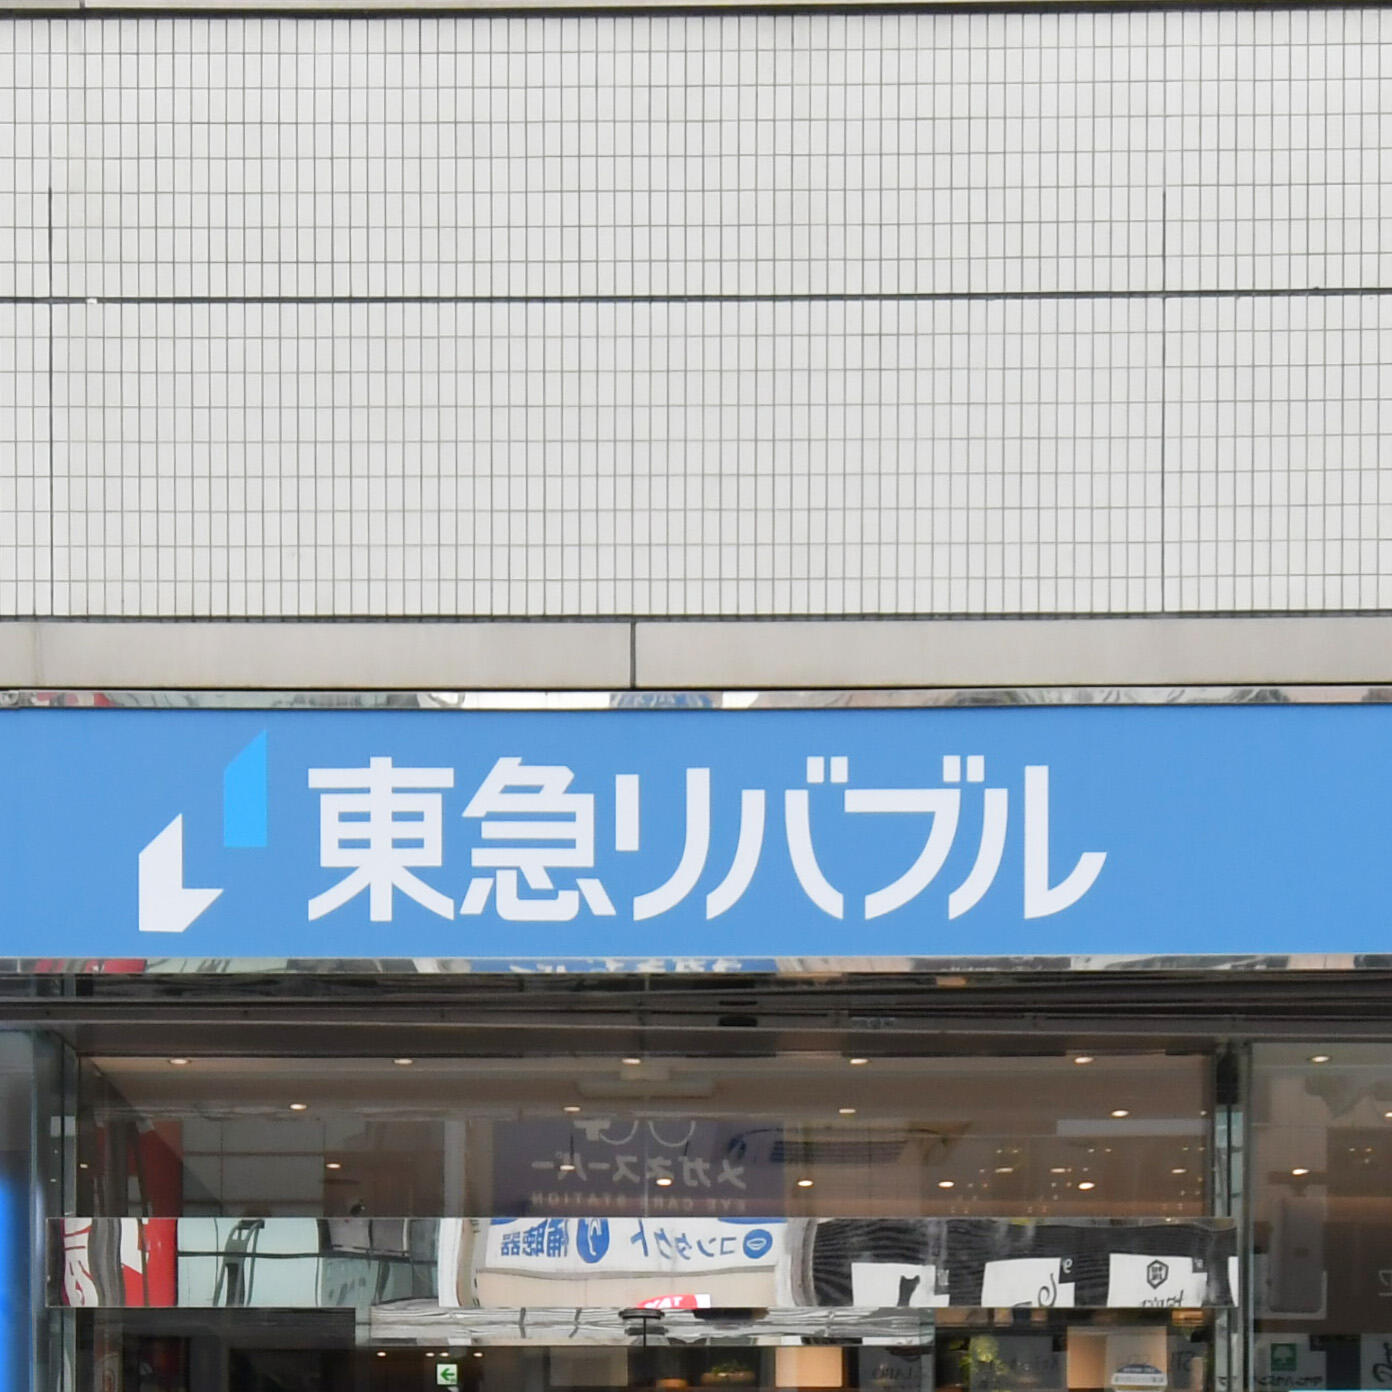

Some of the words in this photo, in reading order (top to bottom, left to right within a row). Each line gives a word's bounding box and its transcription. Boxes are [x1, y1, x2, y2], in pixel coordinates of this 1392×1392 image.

[308, 755, 1107, 922] 東急リバブル
